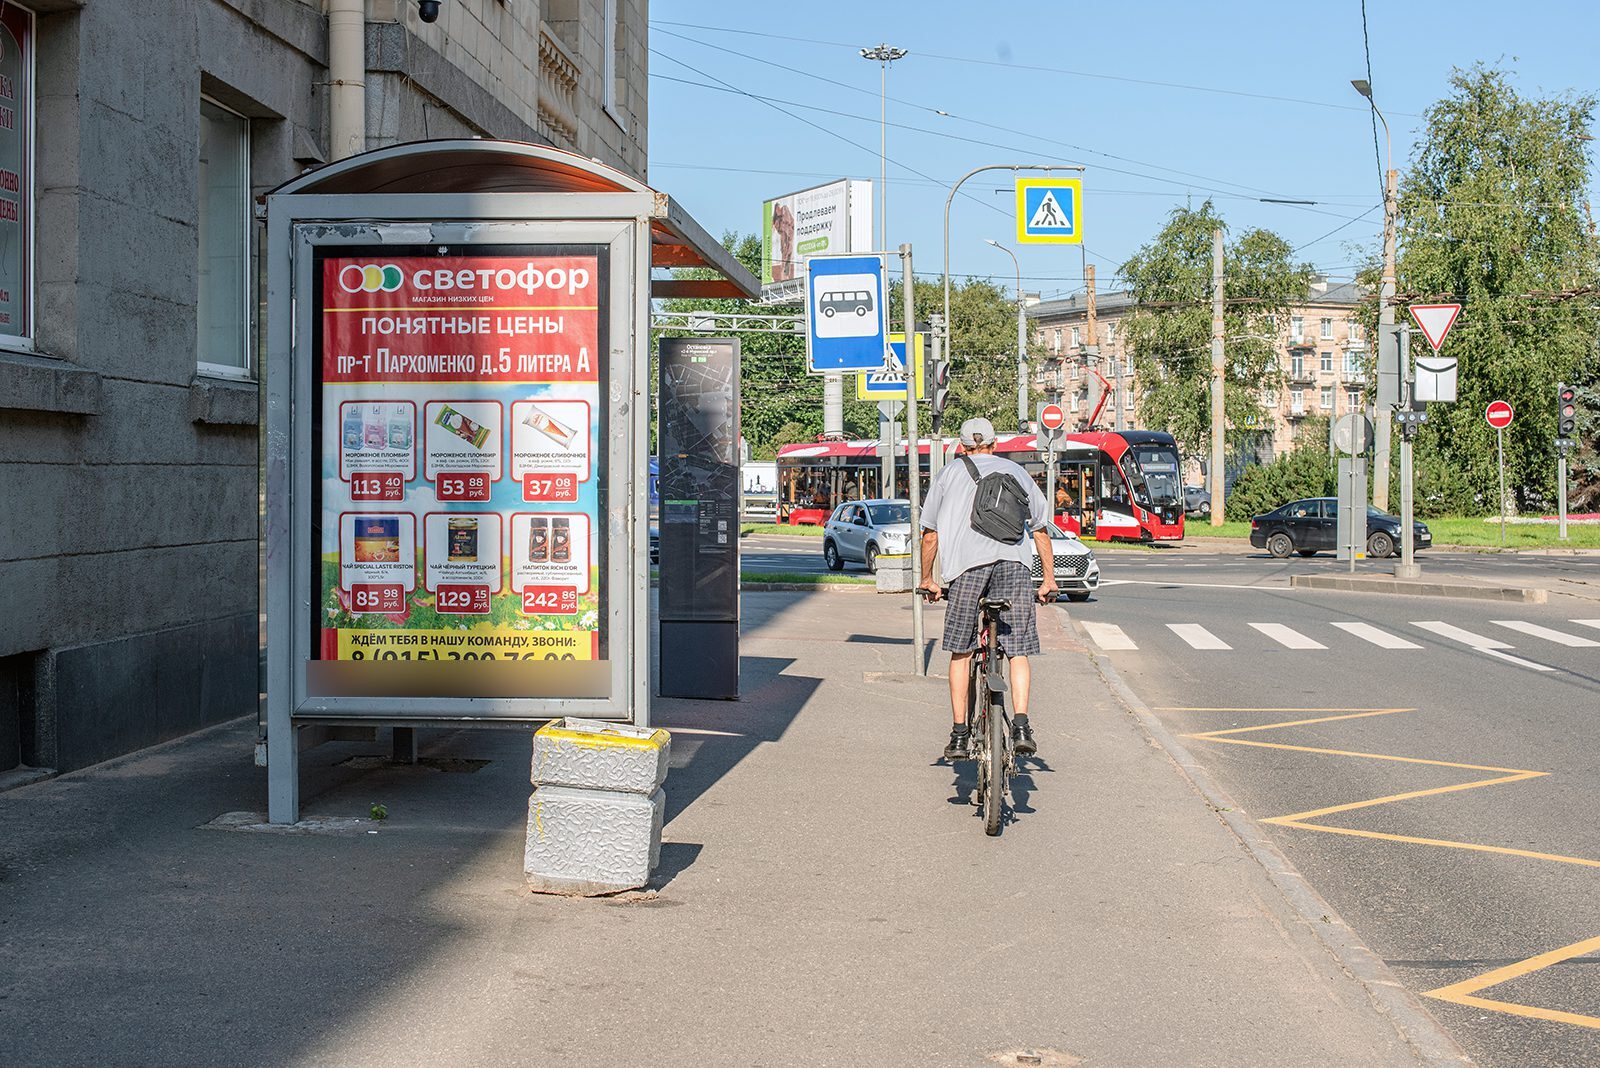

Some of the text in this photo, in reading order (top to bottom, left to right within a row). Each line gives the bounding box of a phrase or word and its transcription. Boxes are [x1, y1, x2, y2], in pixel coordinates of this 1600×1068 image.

[796, 204, 837, 224] Продлеваем
[796, 220, 833, 236] поддержку
[412, 262, 589, 295] светофор
[361, 316, 564, 337] ПОНЯТНЫЕ ЦЕНЫ
[576, 347, 590, 373] А
[353, 477, 401, 495] 113 40
[385, 489, 401, 497] руб.
[442, 477, 483, 495] 53 88
[469, 489, 485, 498] руб.
[529, 478, 571, 495] 37 08
[555, 490, 571, 498] руб.
[356, 589, 398, 606] 85 98
[383, 601, 399, 609] руб.
[439, 590, 487, 607] 129 15
[524, 590, 576, 607] 242 86
[561, 602, 577, 610] руб.
[351, 634, 576, 648] ЖДЁМ ТЕБЯ В НАШУ КОМАНДУ, ЗВОНИ:
